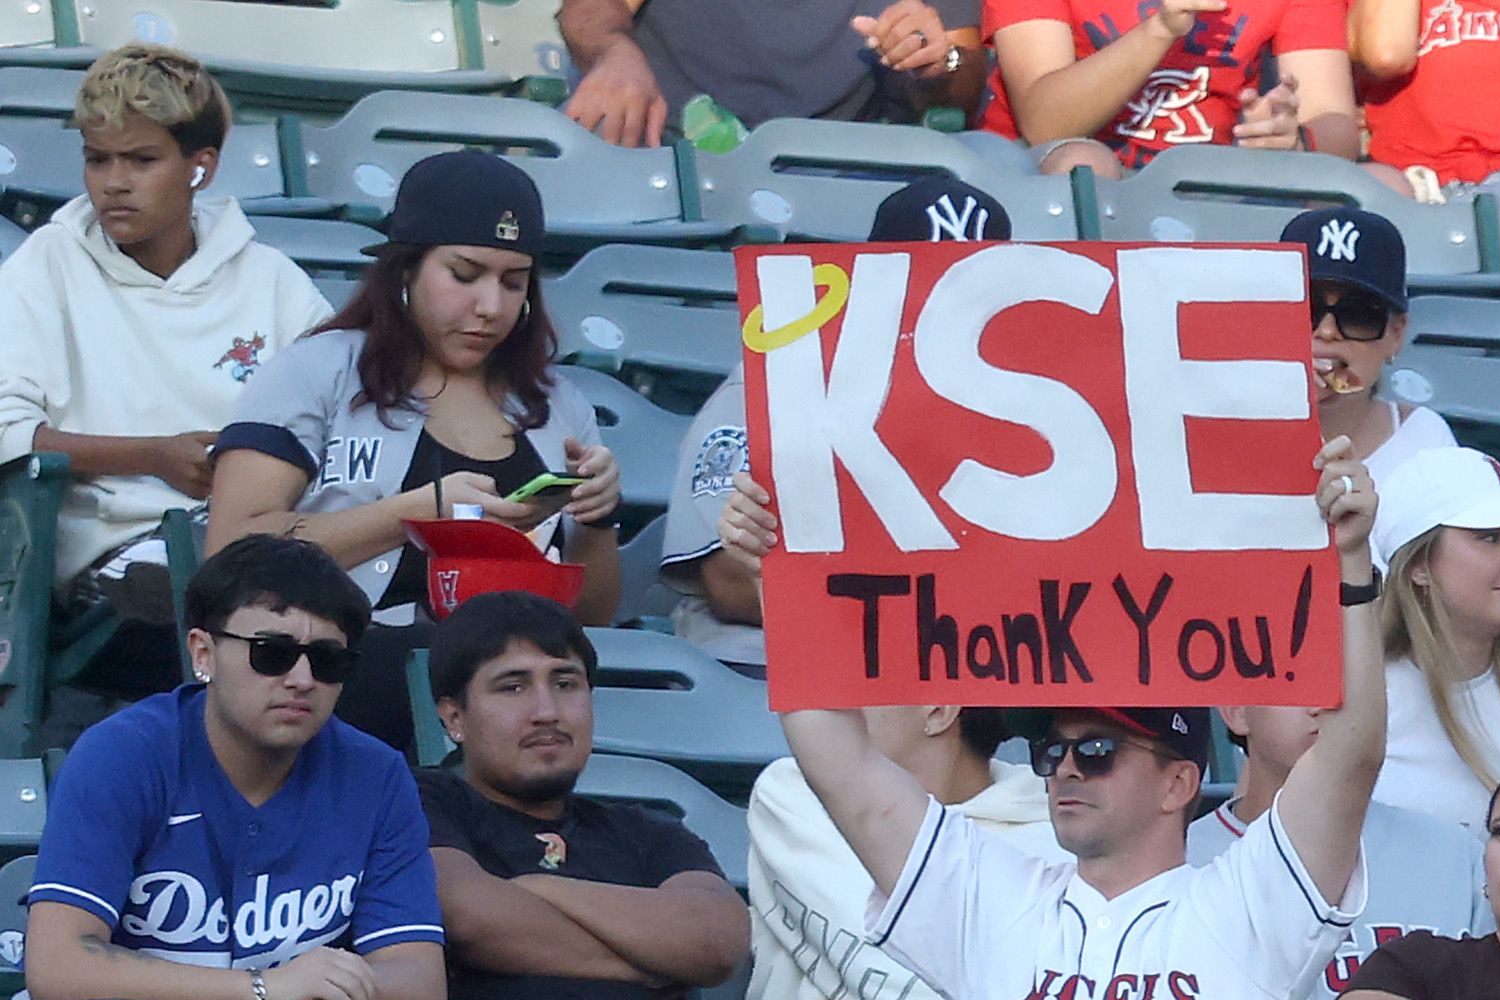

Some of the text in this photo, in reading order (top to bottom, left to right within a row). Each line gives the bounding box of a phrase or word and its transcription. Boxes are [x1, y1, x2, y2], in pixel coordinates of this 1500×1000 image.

[1316, 219, 1360, 261] NY
[755, 243, 1330, 553] KSE
[316, 436, 383, 491] EW
[1112, 565, 1312, 685] You!
[121, 870, 364, 956] Dodger
